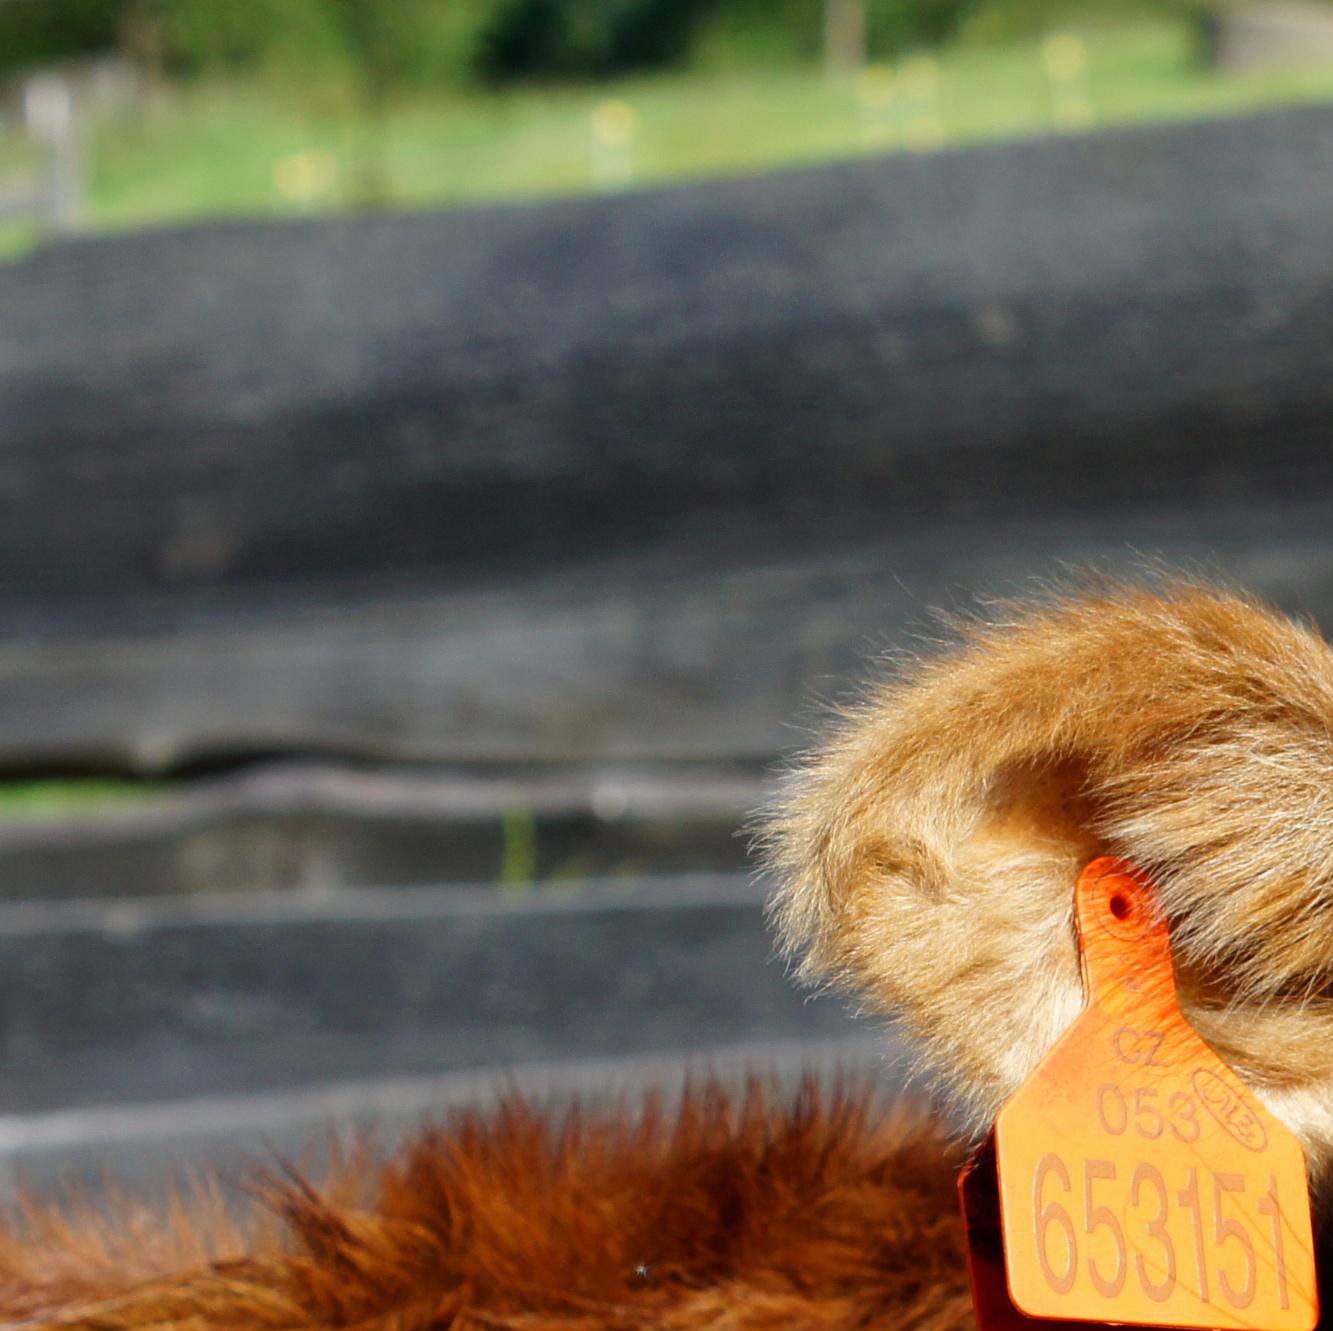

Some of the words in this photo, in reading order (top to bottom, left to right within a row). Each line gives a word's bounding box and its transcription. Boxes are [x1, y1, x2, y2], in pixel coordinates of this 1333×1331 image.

[1113, 1026, 1169, 1068] CZ
[1097, 1083, 1200, 1143] 053
[1032, 1153, 1290, 1311] 653151
